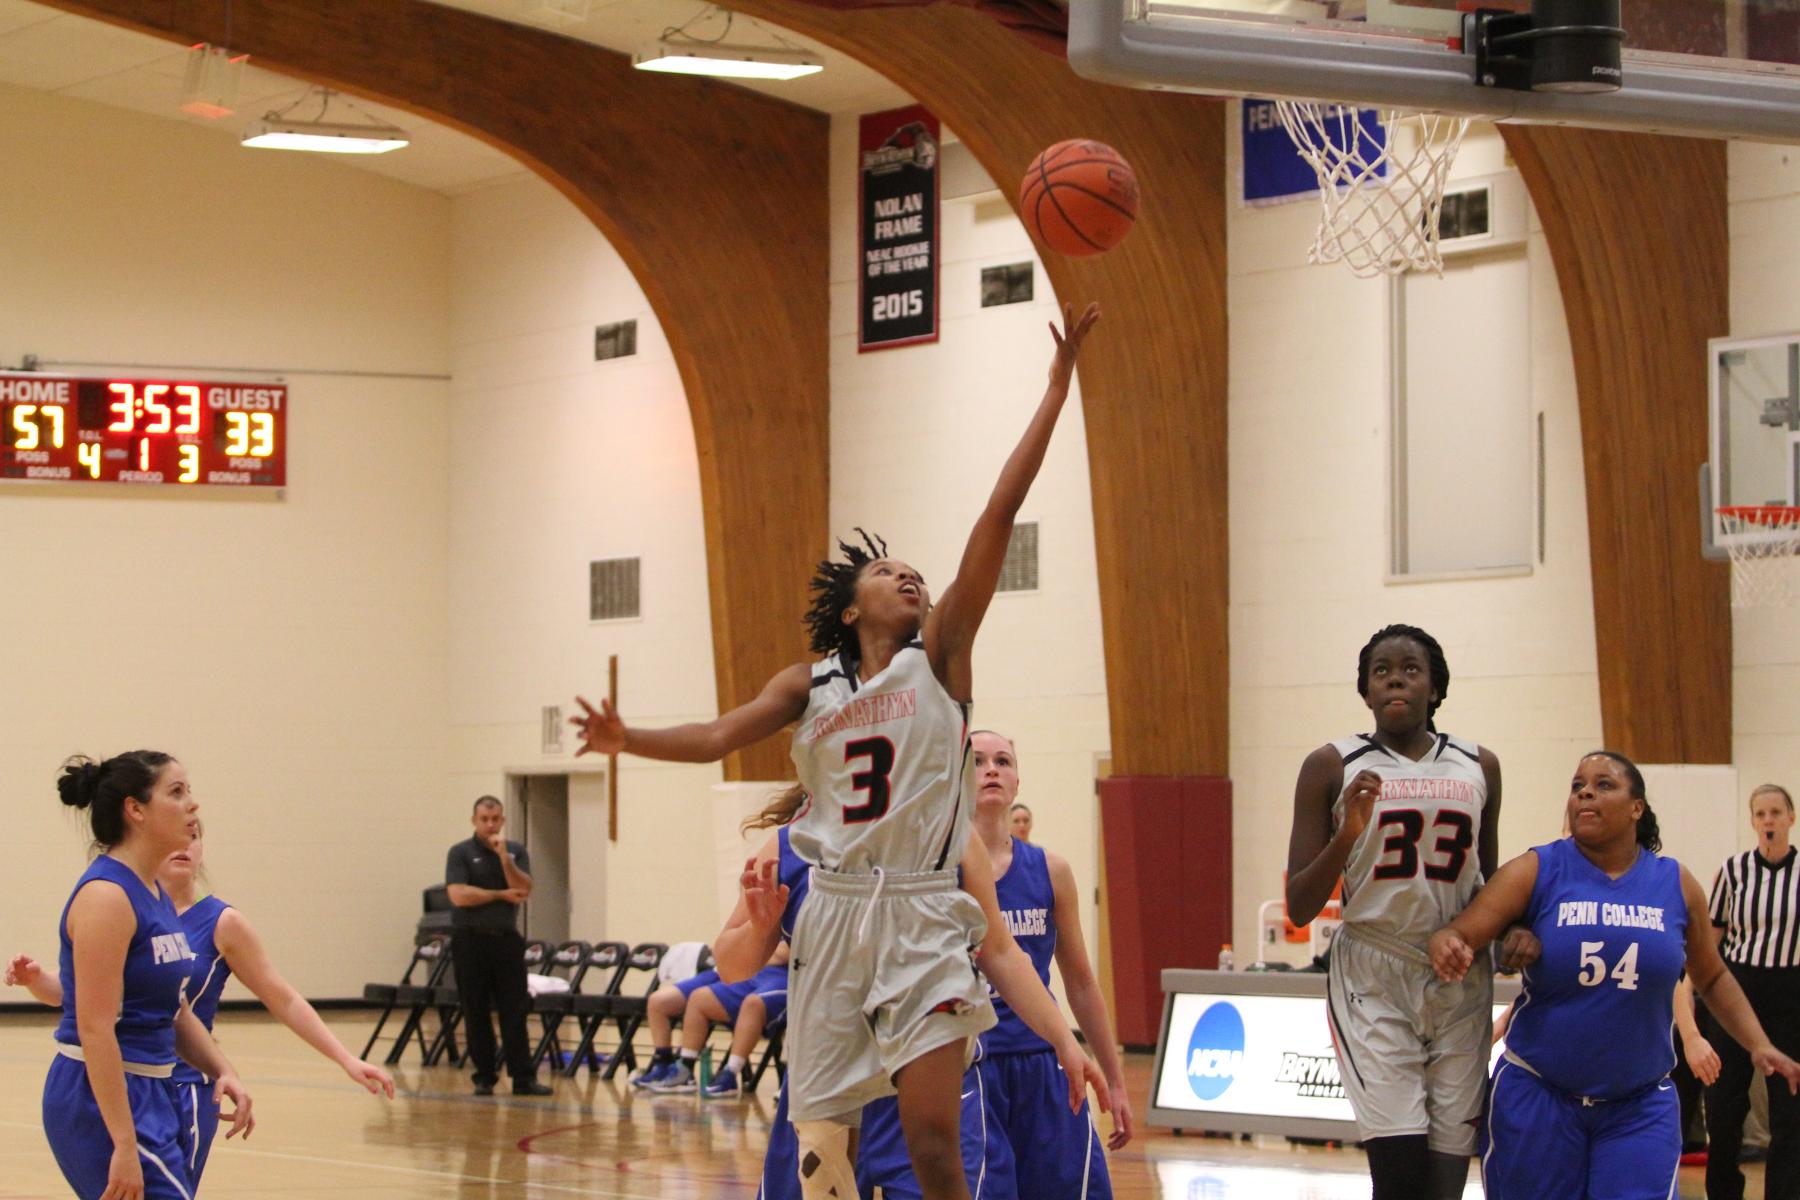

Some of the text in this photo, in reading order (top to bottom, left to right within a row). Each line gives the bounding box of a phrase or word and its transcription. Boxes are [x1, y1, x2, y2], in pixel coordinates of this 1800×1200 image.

[874, 193, 923, 218] NOLAN
[874, 214, 923, 240] FRAME
[868, 254, 929, 277] OF THE YEAR
[872, 289, 923, 322] 2015
[0, 380, 70, 403] HOME
[207, 387, 284, 410] GUEST
[107, 382, 200, 434] 3:53
[12, 403, 65, 449] 57
[224, 411, 275, 457] 33
[15, 450, 49, 463] POSS
[78, 442, 101, 479] 4
[139, 437, 150, 472] 1
[178, 444, 200, 483] 3
[229, 456, 262, 469] POSS
[27, 466, 71, 478] BONUS
[118, 470, 163, 482] PERIOD
[208, 471, 250, 483] BONUS
[843, 736, 895, 825] 3
[1377, 778, 1474, 805] RYNATHYN
[1373, 808, 1472, 883] 33
[1557, 901, 1665, 932] PENN COLLEGE
[1578, 941, 1639, 990] 54
[1188, 1048, 1245, 1079] NCAA
